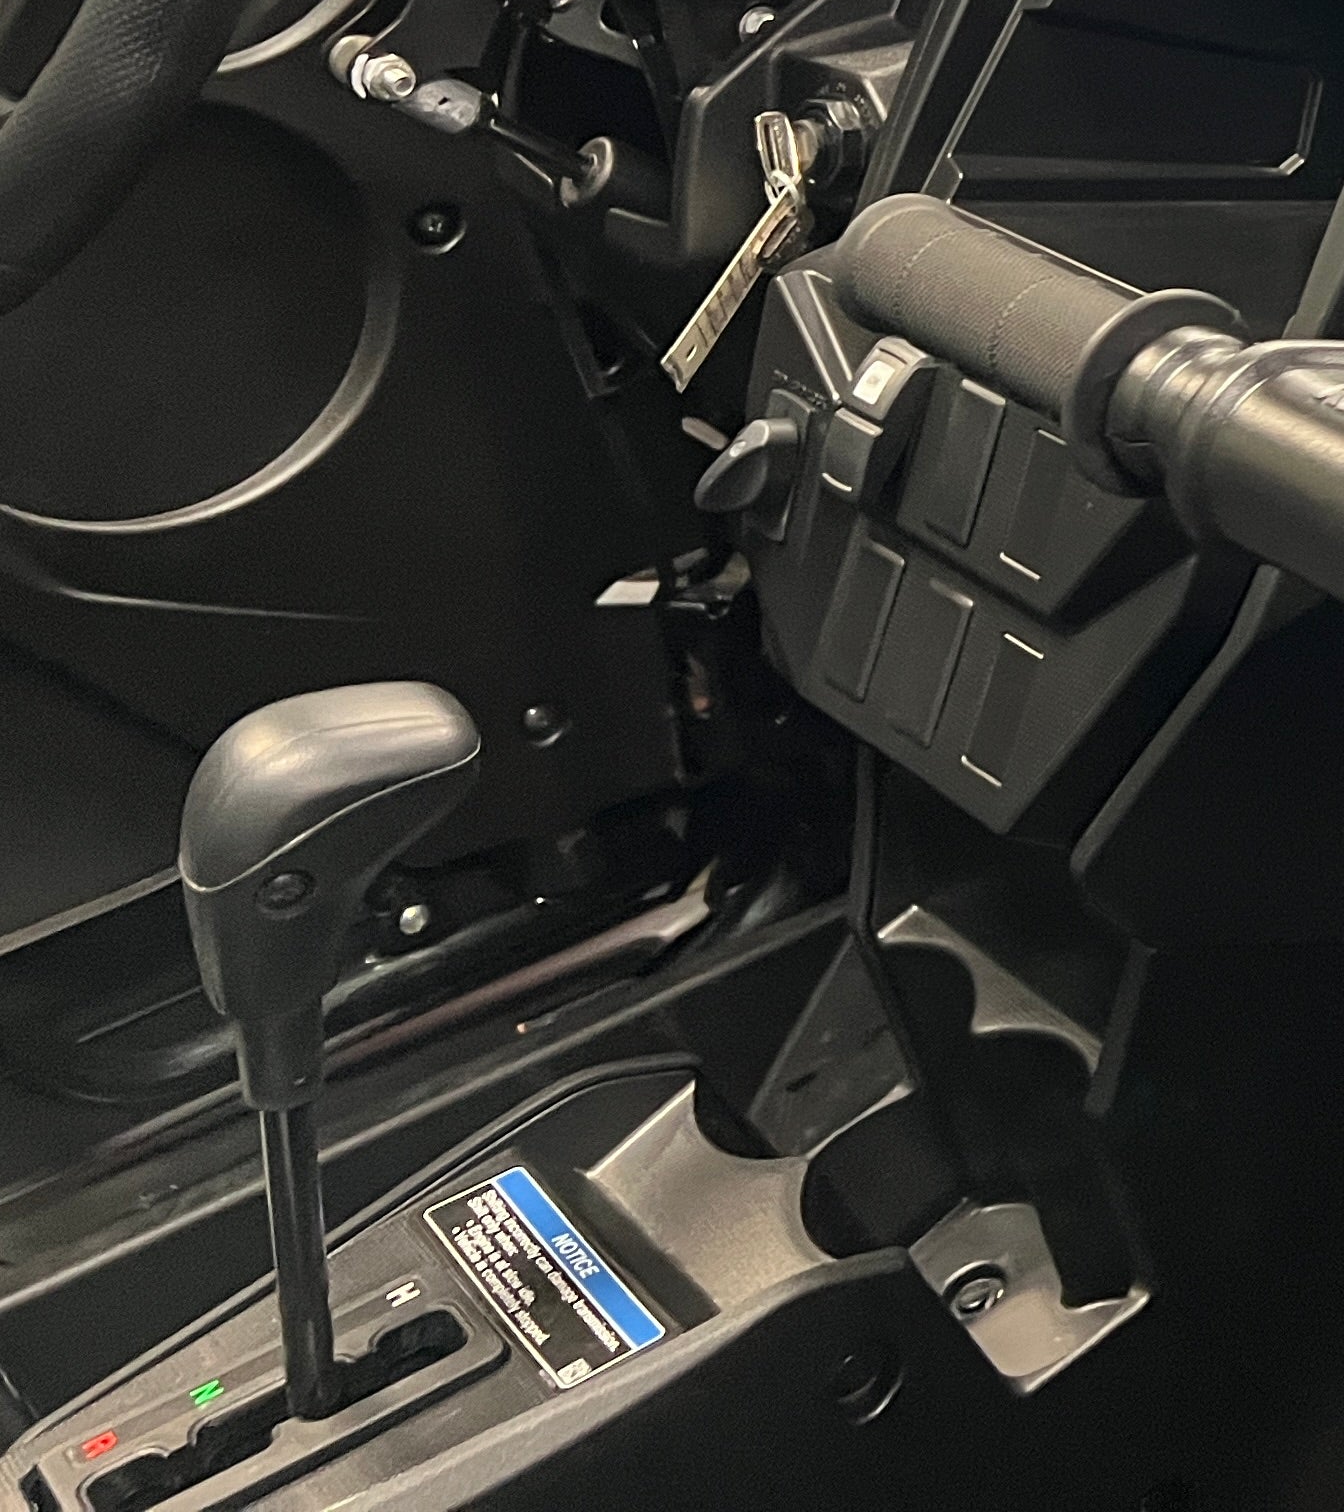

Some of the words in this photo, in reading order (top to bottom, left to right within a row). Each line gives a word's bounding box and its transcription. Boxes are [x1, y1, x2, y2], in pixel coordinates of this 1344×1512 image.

[551, 1233, 601, 1279] NOTICE
[385, 1281, 421, 1308] H
[190, 1379, 225, 1405] N
[81, 1430, 119, 1460] R
